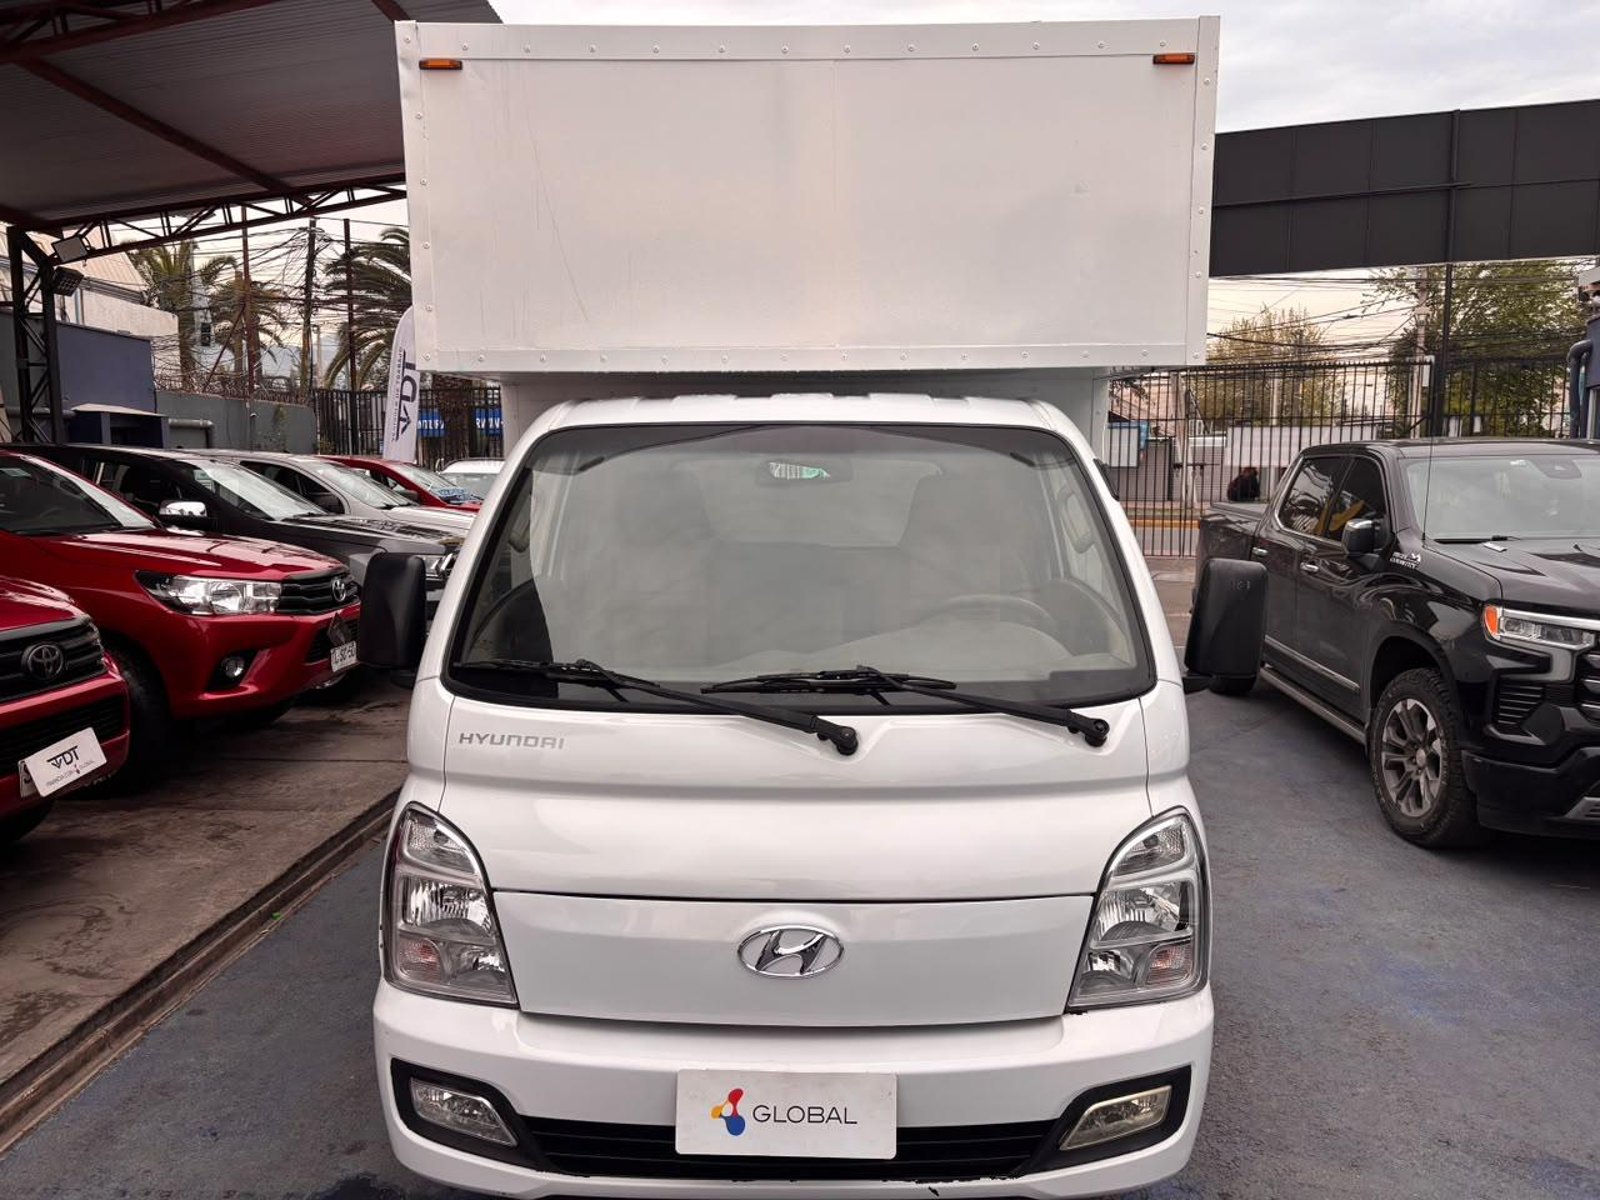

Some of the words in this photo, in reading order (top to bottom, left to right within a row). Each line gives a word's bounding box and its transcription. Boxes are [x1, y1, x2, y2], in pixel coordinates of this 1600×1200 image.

[458, 732, 565, 750] HYUNDAI
[46, 745, 80, 769] VDT
[752, 1104, 858, 1125] GLOBAL
